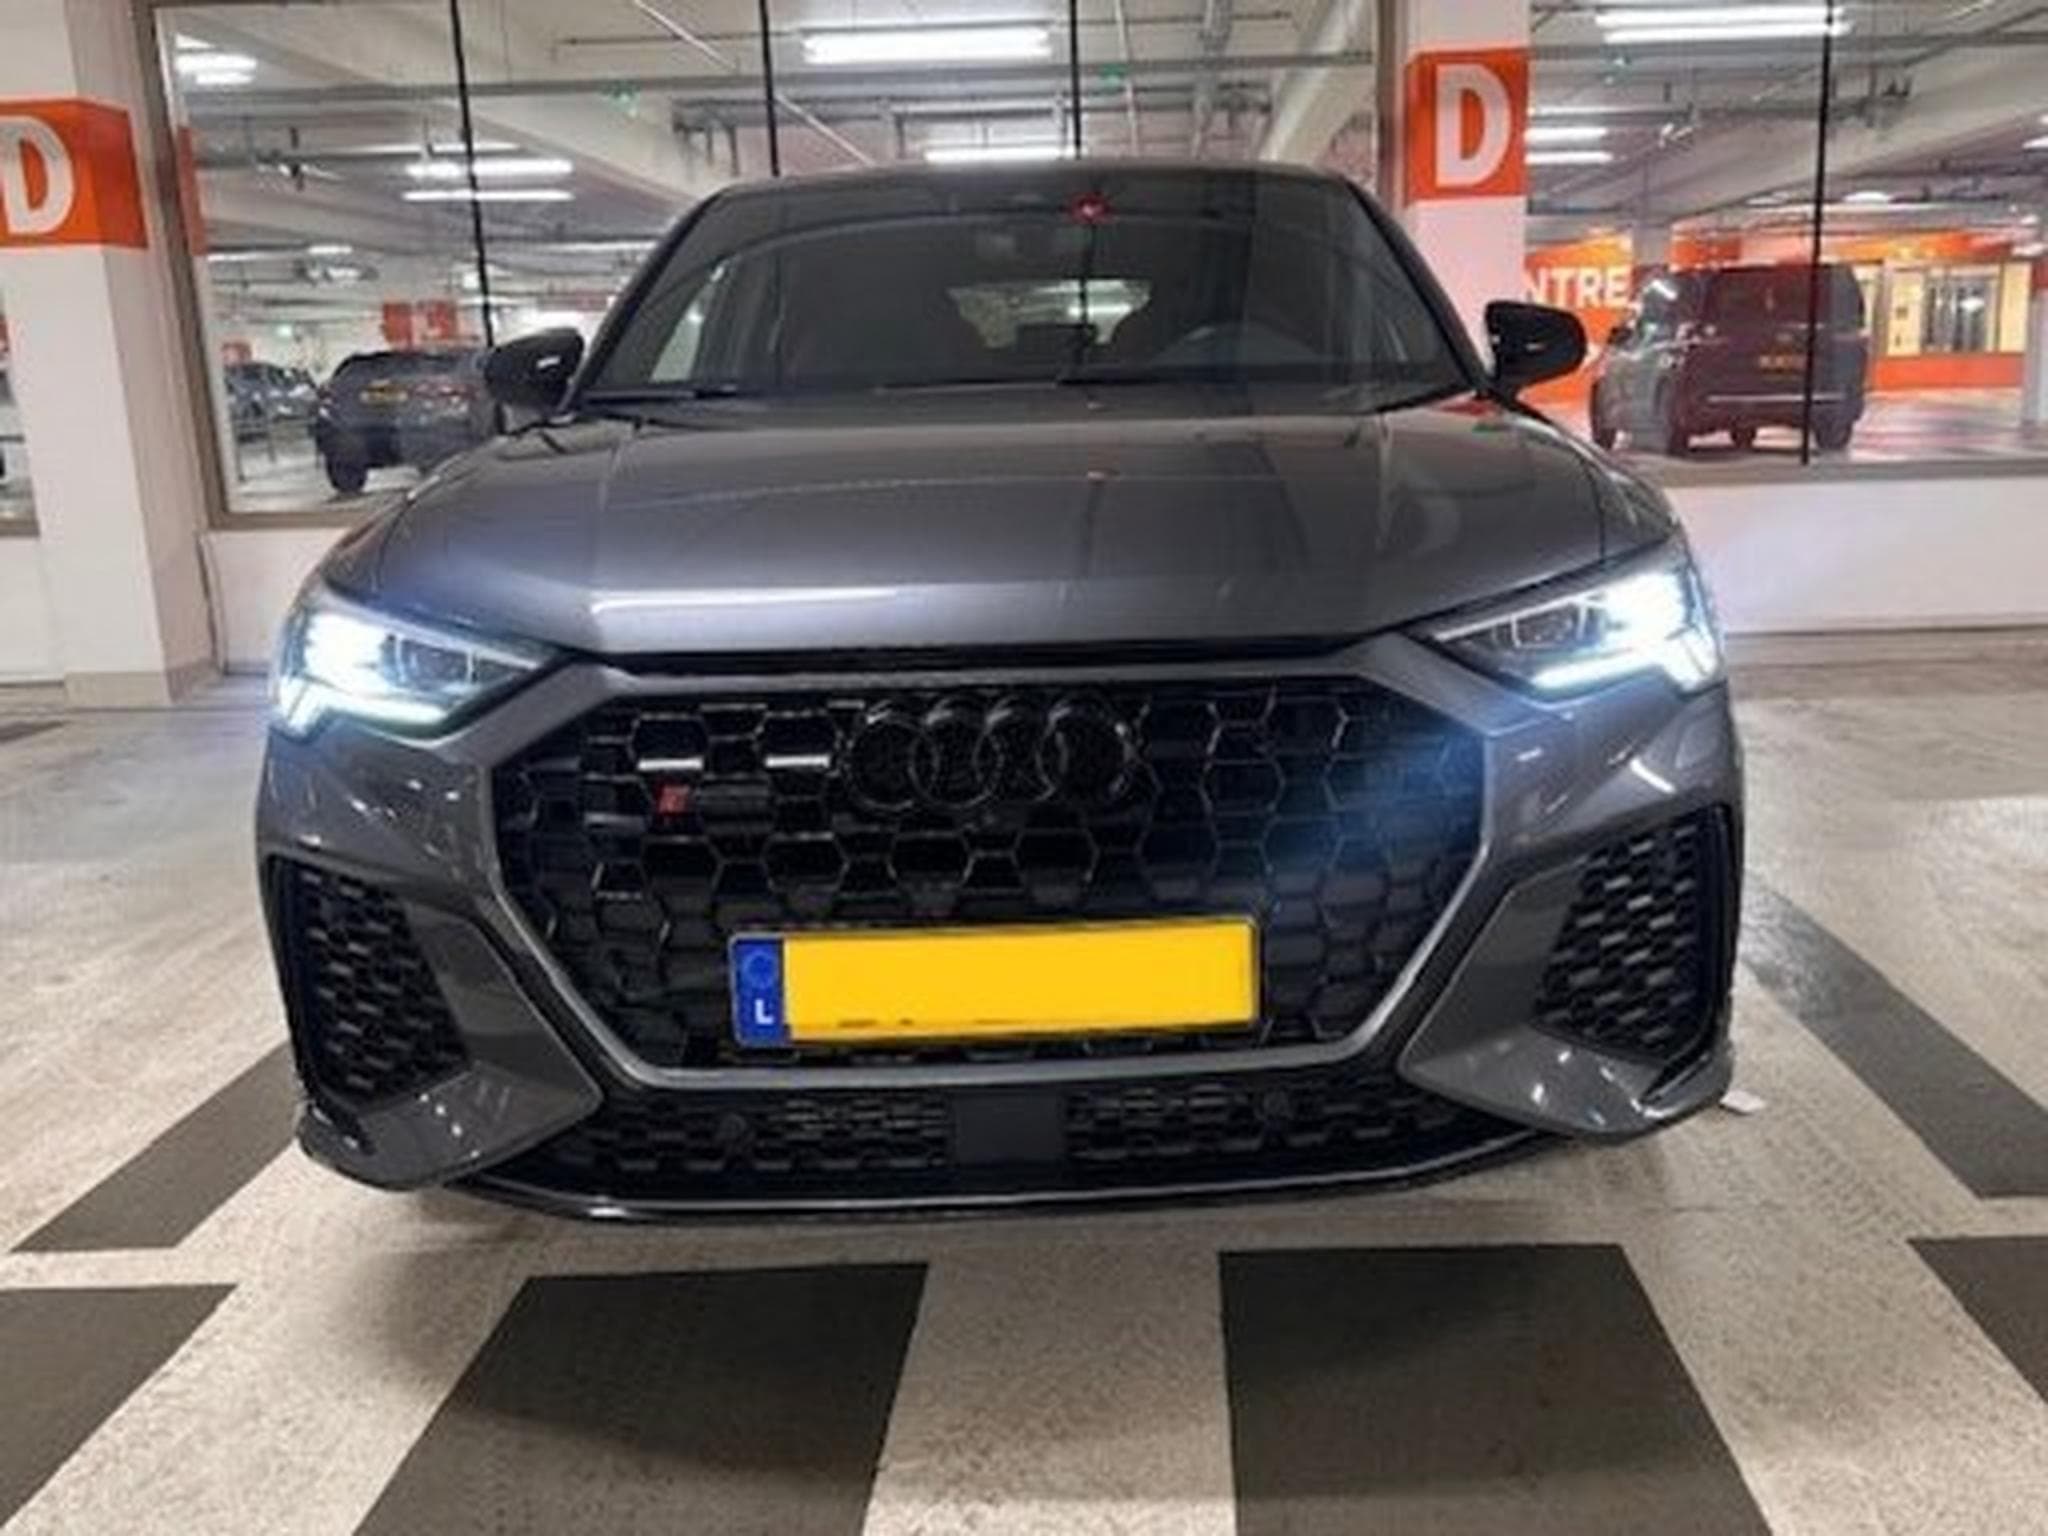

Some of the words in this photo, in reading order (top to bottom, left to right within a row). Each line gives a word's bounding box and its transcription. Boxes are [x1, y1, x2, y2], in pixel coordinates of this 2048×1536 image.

[0, 115, 75, 234] D
[1434, 63, 1511, 187] D
[755, 999, 774, 1024] L
